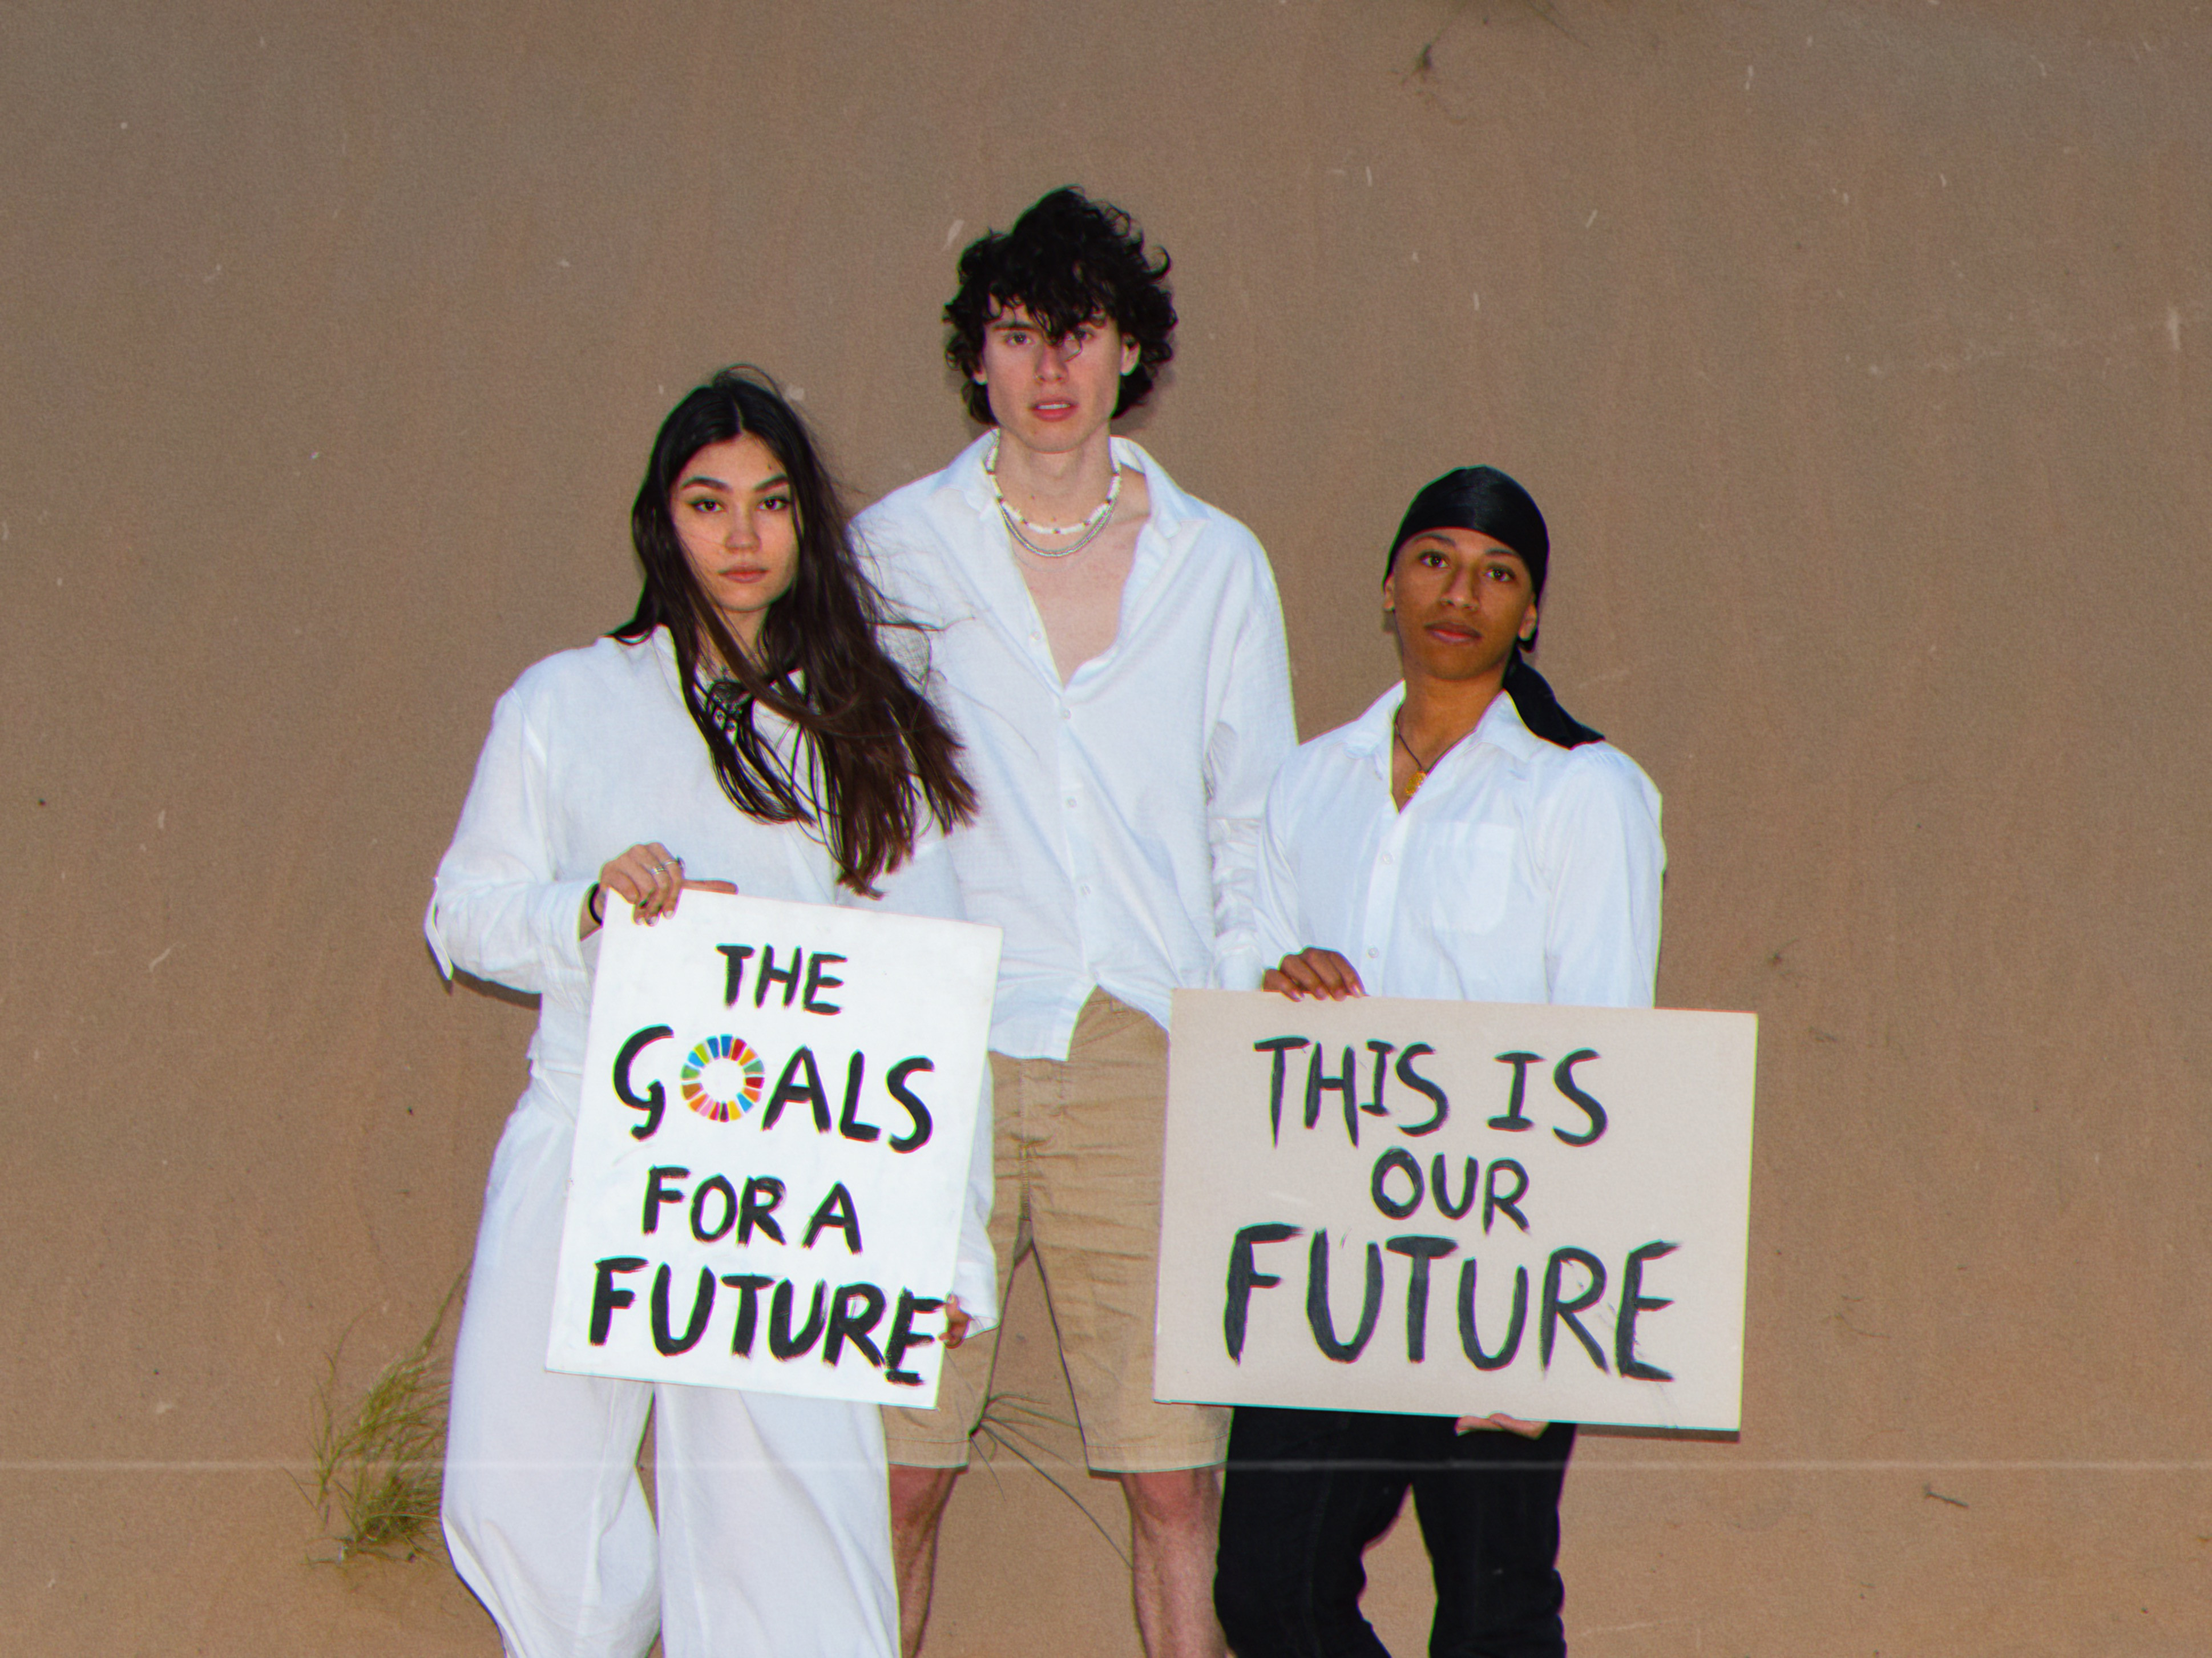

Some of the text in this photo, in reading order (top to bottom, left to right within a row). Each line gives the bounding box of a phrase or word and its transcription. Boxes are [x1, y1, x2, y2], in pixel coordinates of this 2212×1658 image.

[716, 944, 847, 1015] THE
[1253, 1035, 1609, 1148] THIS IS
[643, 1165, 863, 1254] FOR A
[1370, 1147, 1531, 1235] OUR
[588, 1256, 946, 1386] FUTURE
[1223, 1221, 1681, 1383] FUTURE
